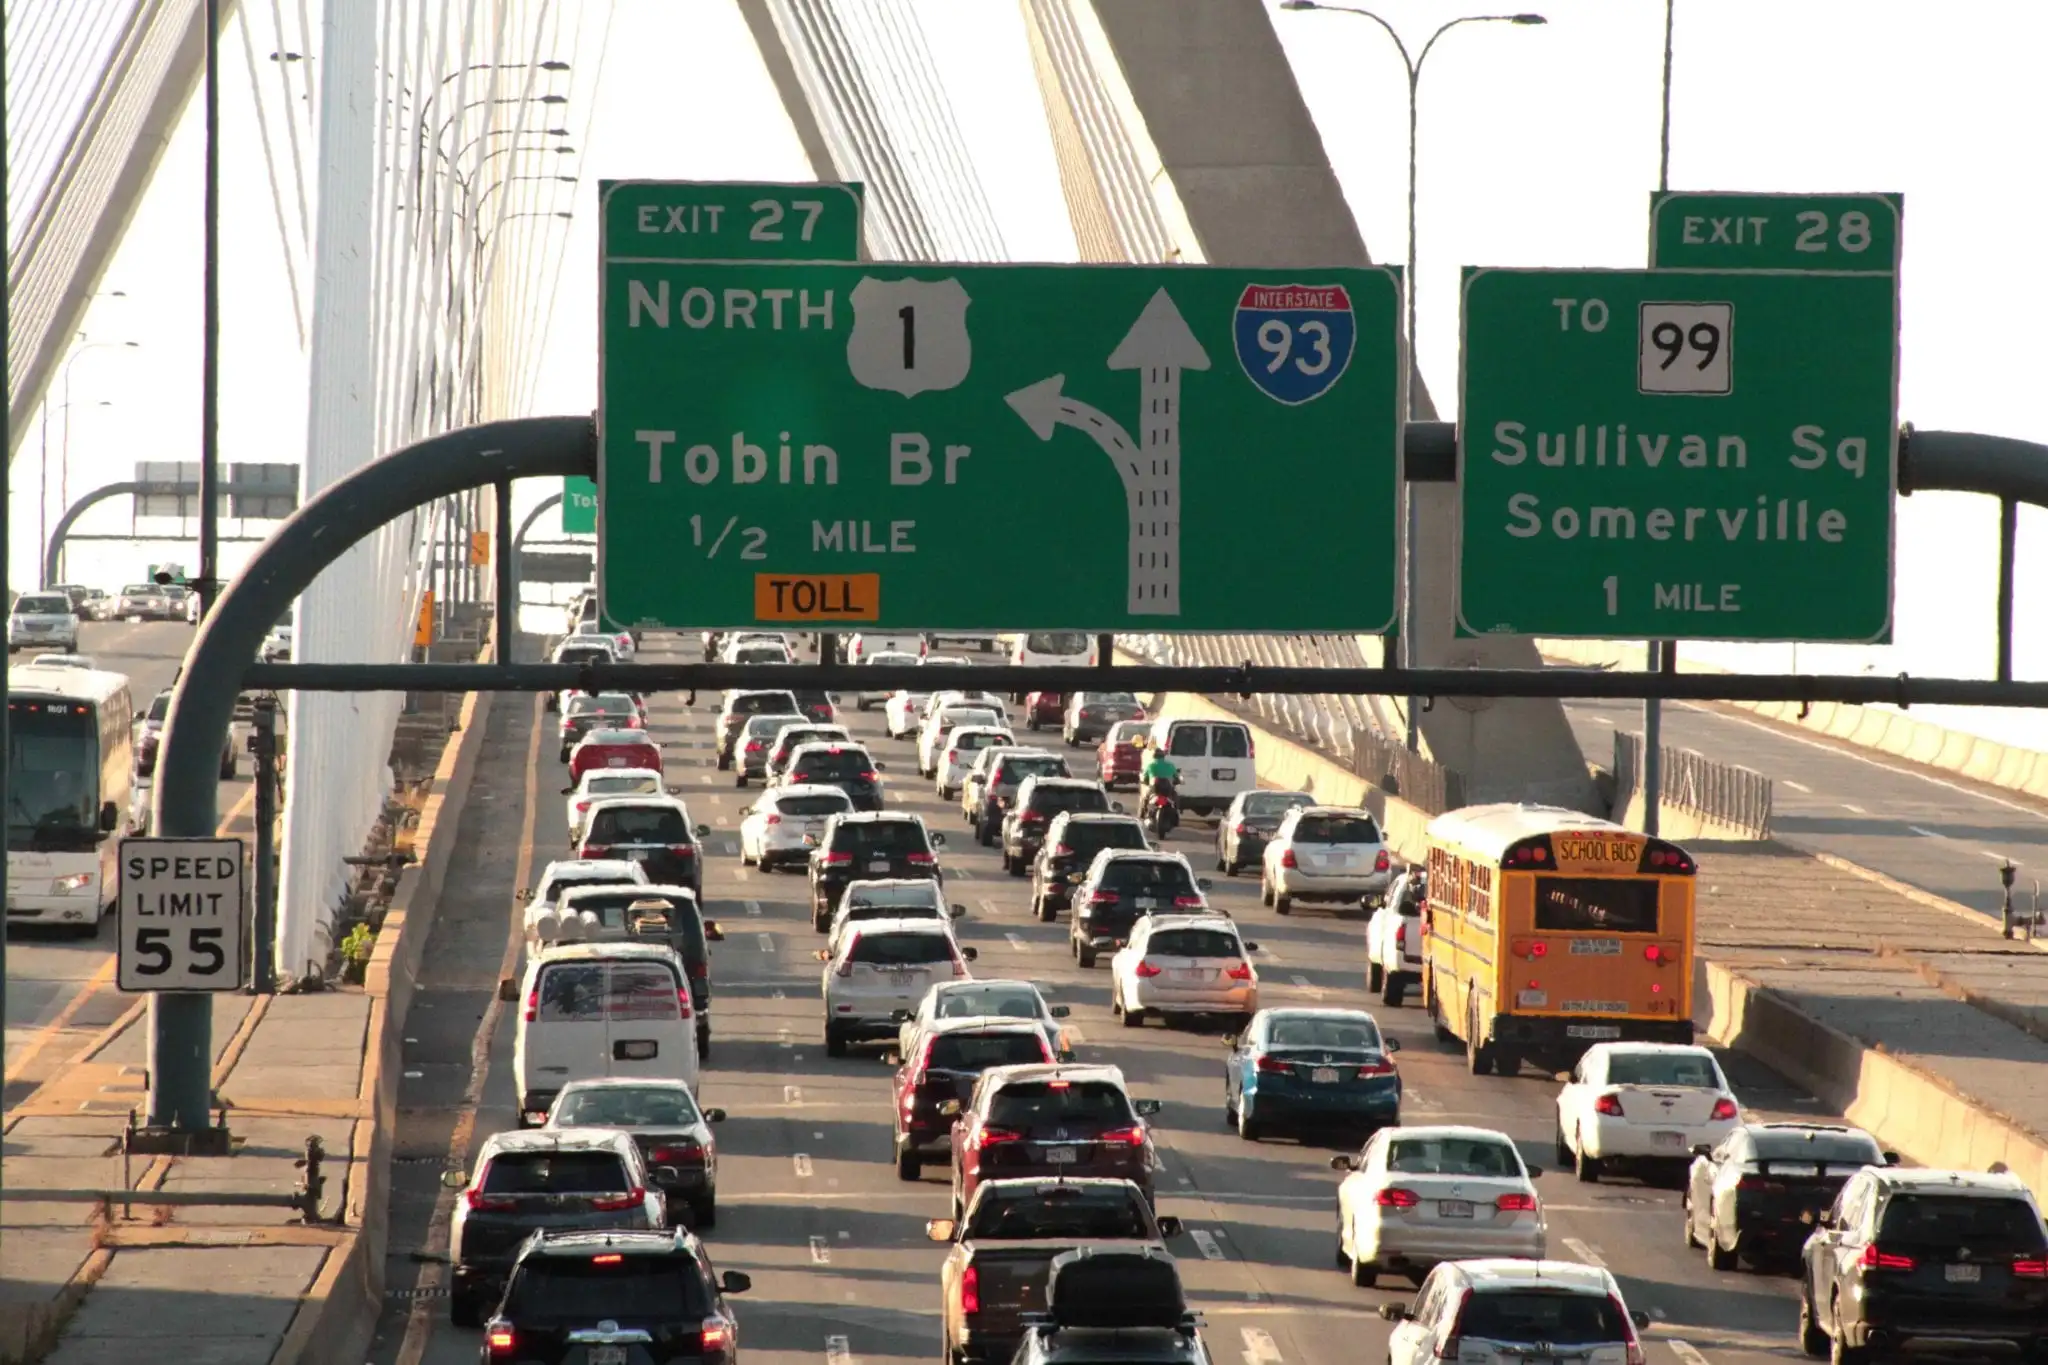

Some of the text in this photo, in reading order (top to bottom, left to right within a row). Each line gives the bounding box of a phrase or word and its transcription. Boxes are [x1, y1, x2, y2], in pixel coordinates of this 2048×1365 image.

[638, 199, 824, 241] EXIT 27
[1683, 211, 1871, 253] EXIT 28
[628, 280, 834, 330] NORTH
[1254, 292, 1335, 307] INTERSTATE
[1552, 298, 1609, 332] TO
[899, 306, 914, 370] 1
[1257, 319, 1332, 375] 93
[1651, 322, 1720, 372] 99
[635, 430, 971, 486] Tobin Br
[1491, 422, 1867, 478] Sullivan Sq
[690, 515, 916, 560] 1/2 MILE
[1505, 493, 1847, 542] Somerville
[770, 580, 864, 613] TOLL
[1603, 575, 1741, 616] 1 MILE
[128, 857, 235, 880] SPEED
[1561, 841, 1637, 862] SCHOOL BUS
[137, 893, 223, 917] LIMIT
[135, 927, 225, 976] 55
